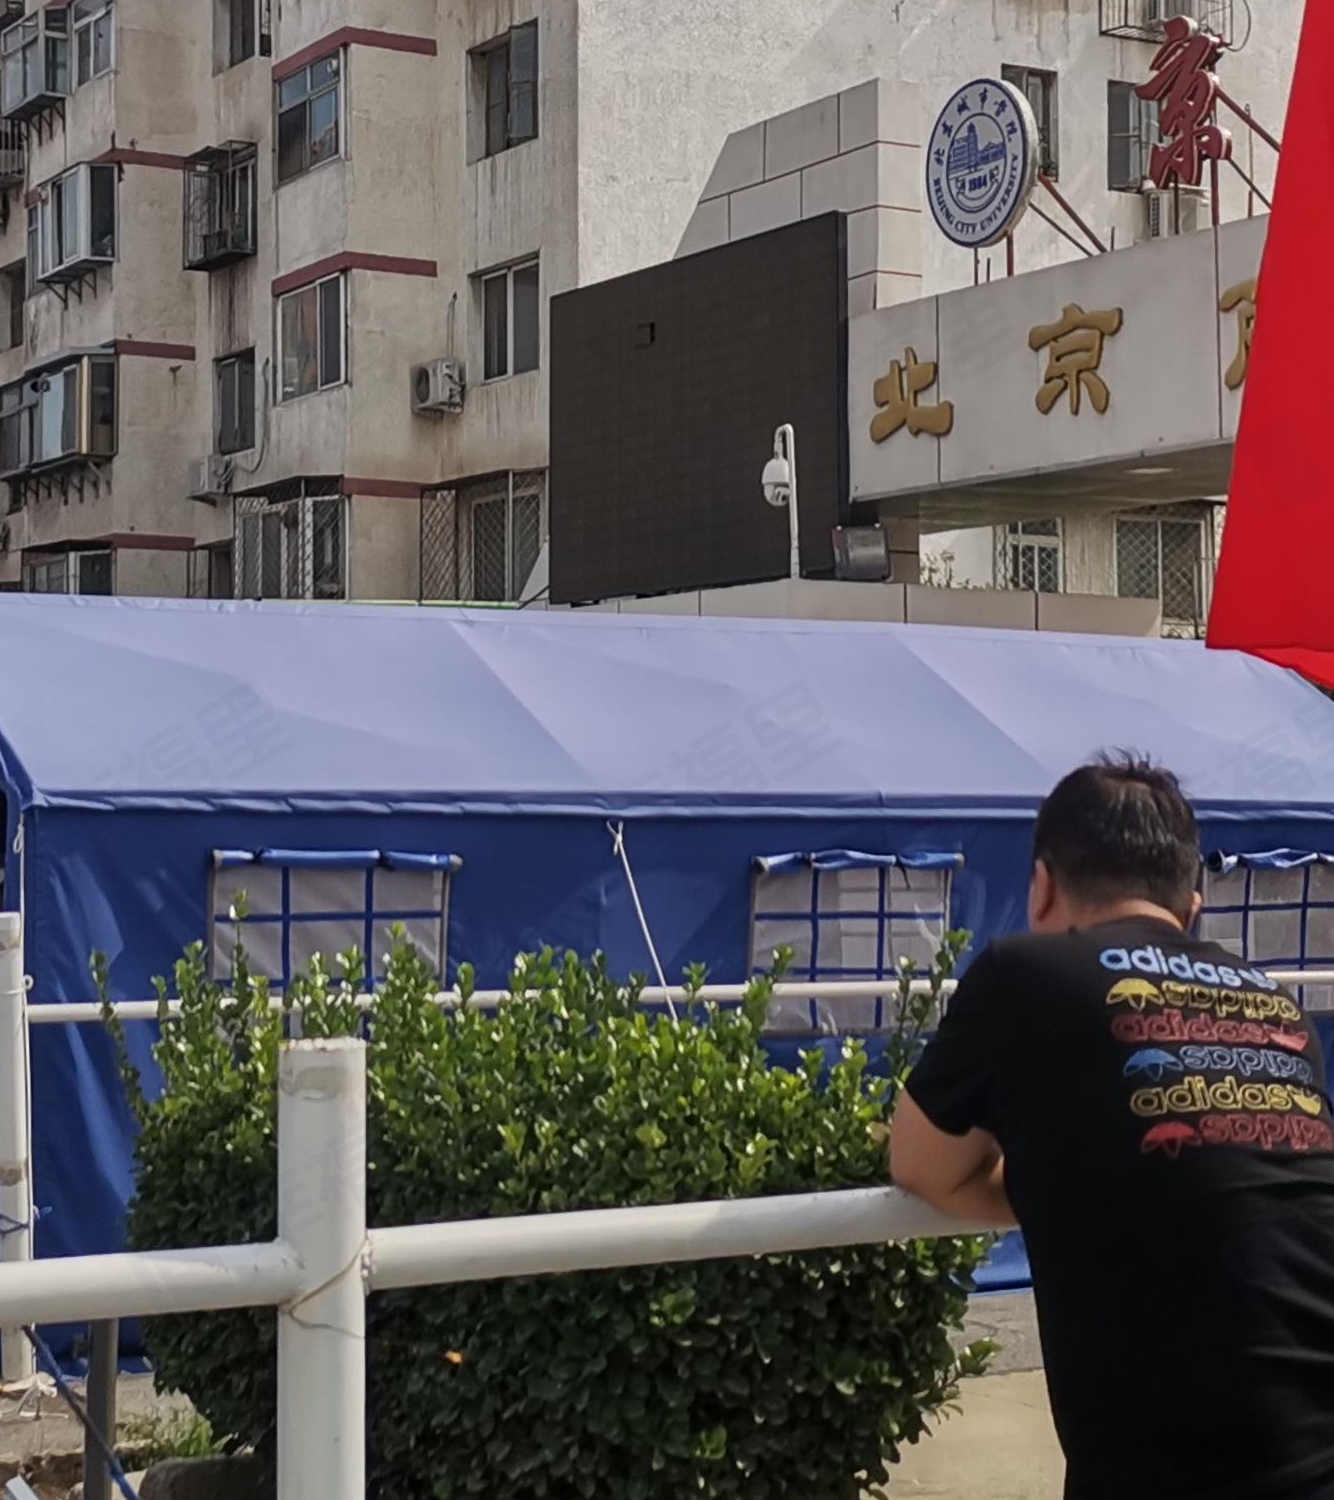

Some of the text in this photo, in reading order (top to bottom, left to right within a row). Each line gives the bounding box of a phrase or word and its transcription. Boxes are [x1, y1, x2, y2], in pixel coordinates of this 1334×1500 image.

[1100, 945, 1242, 987] adidas
[1112, 1008, 1269, 1043] adidas
[1130, 1076, 1293, 1116] adidas
